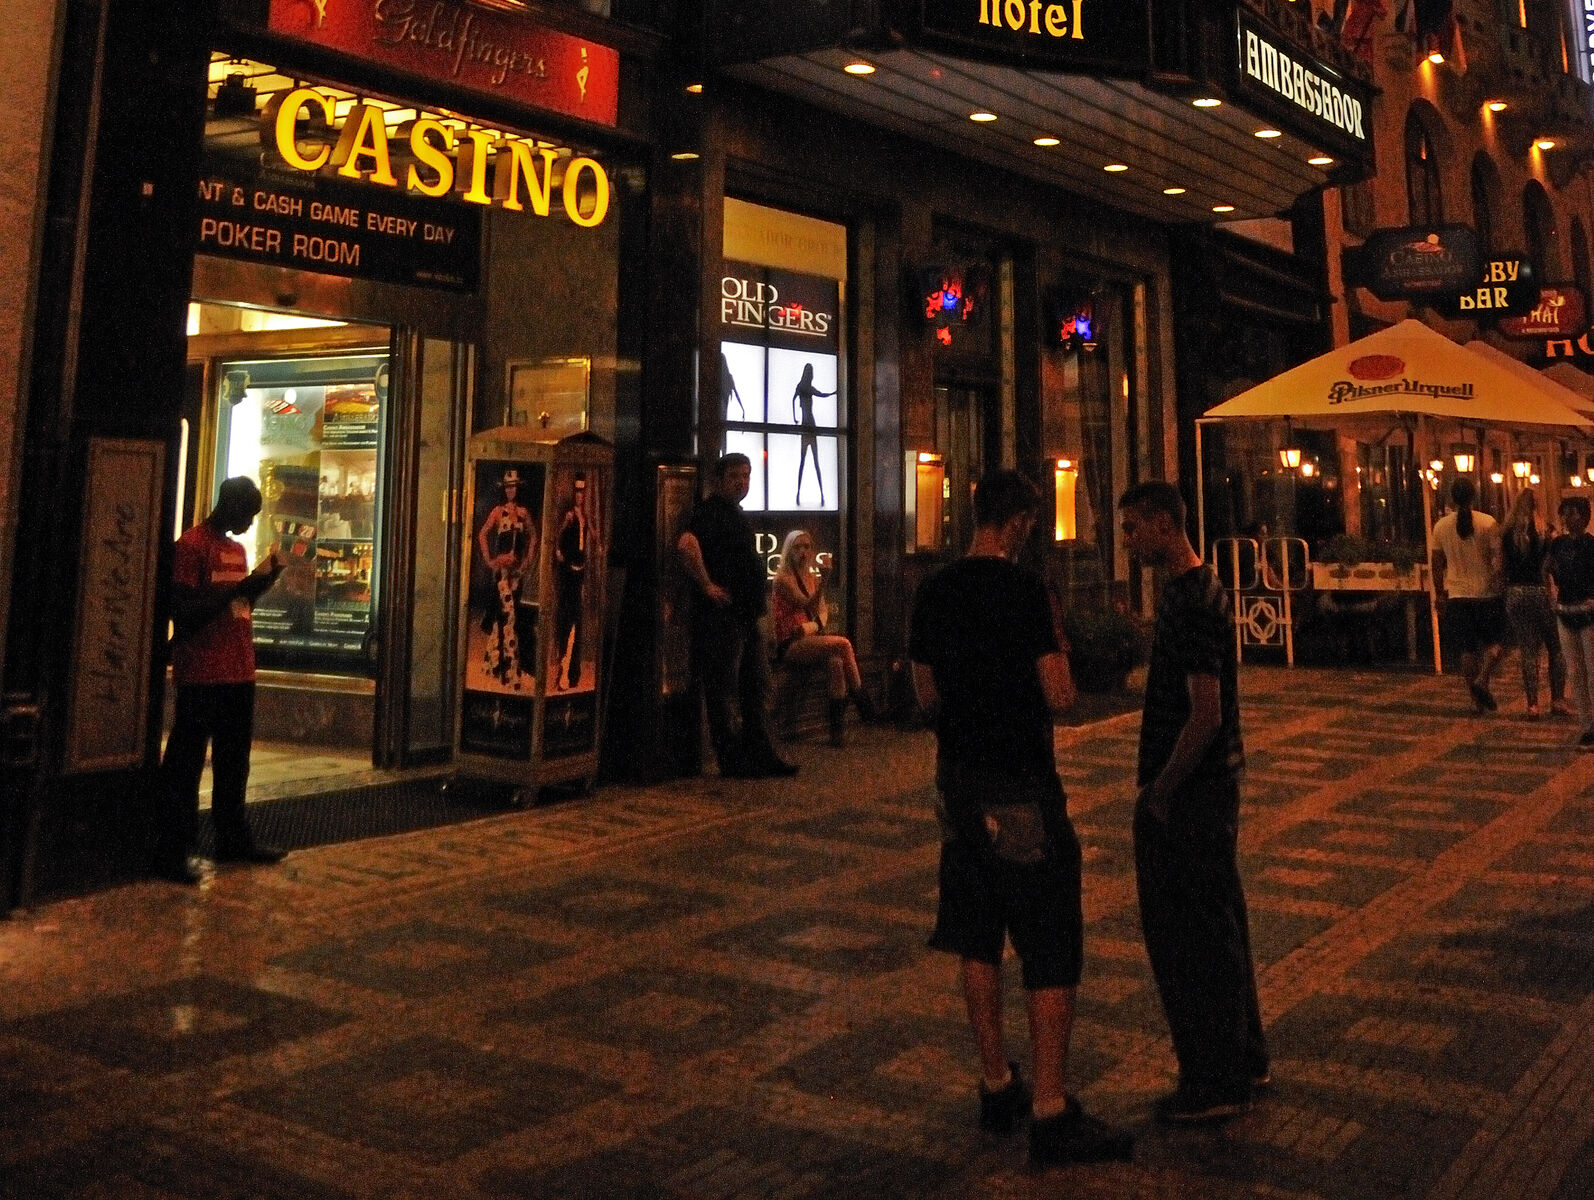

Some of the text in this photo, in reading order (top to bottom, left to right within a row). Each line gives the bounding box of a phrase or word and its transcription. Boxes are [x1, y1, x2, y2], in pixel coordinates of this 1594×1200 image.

[1246, 29, 1365, 140] AMBASSADOR
[275, 88, 610, 228] CASINO
[199, 218, 361, 267] POKER ROOM
[231, 184, 245, 207] &
[253, 191, 303, 218] CASH
[310, 202, 360, 228] GAME
[366, 212, 418, 238] EVERY
[423, 223, 457, 245] DAY
[1328, 378, 1474, 405] Pilsner Urquell
